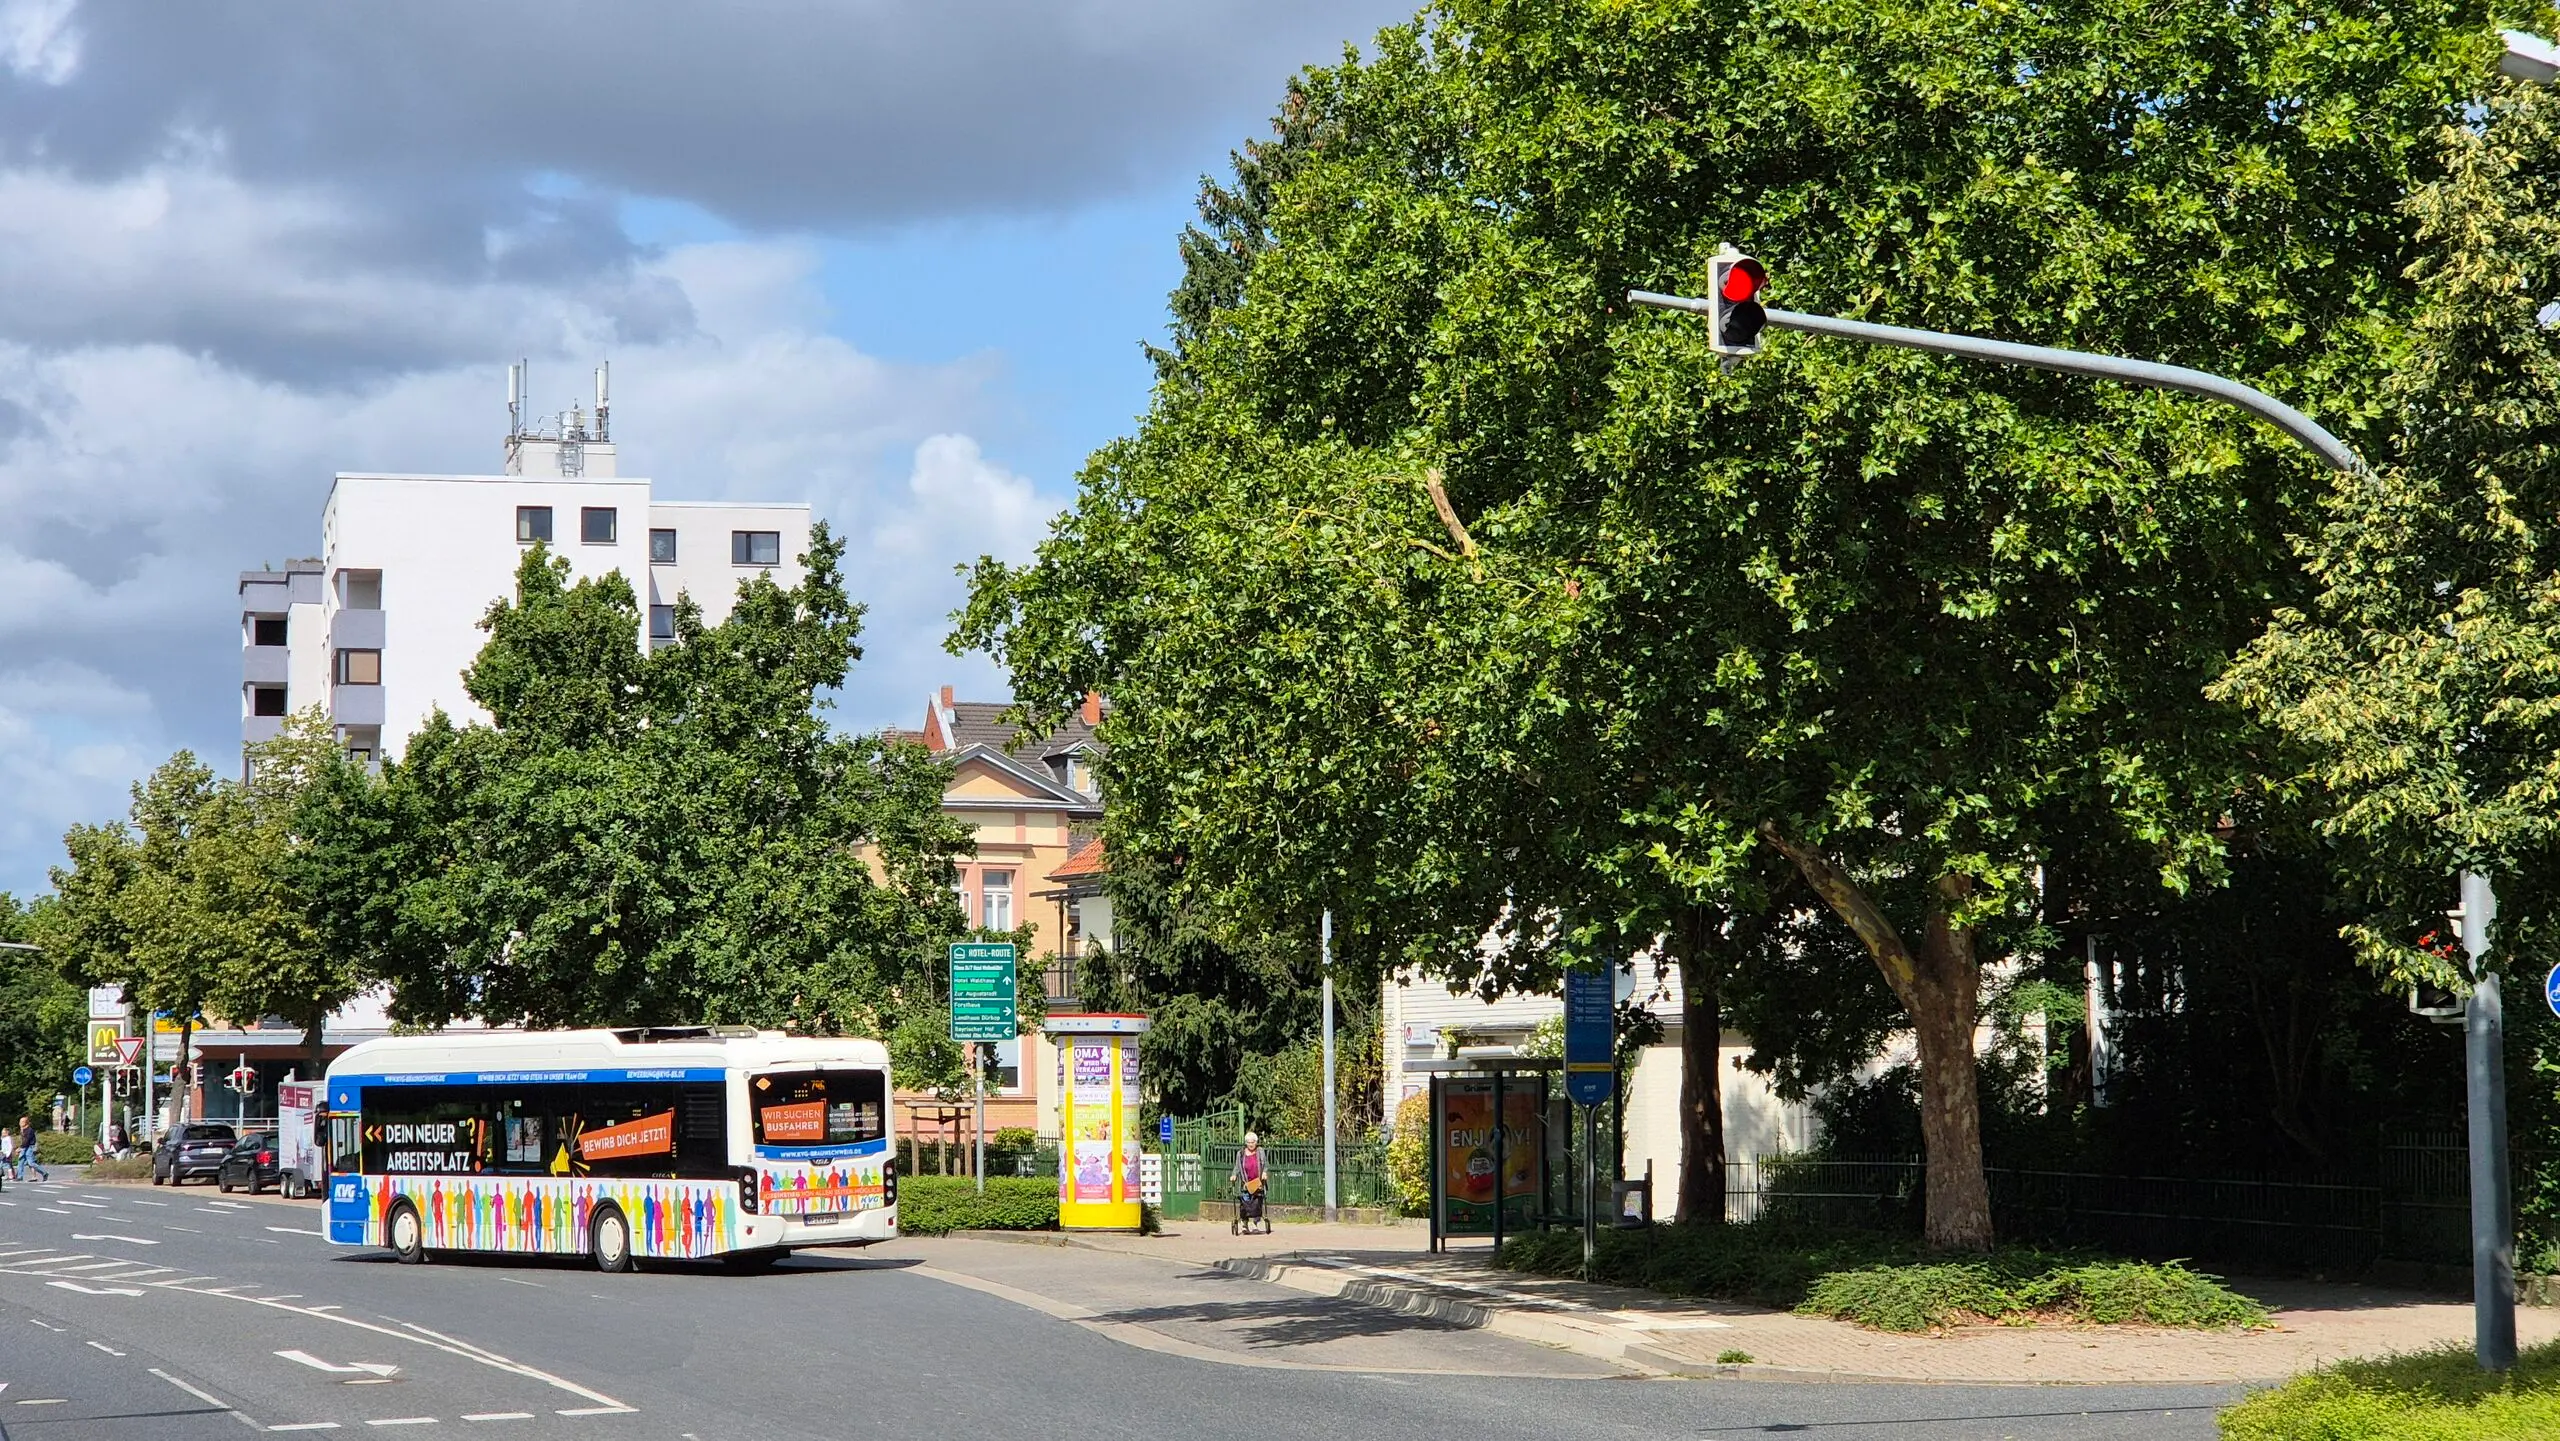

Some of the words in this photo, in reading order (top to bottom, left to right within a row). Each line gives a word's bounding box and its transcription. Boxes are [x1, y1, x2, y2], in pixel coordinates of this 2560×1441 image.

[969, 949, 1011, 957] HOTEL-ROUTE
[1075, 1048, 1099, 1059] OMA
[763, 1111, 781, 1120] WIR
[783, 1109, 821, 1119] SUCHEN
[766, 1121, 820, 1132] BUSFAHRER
[385, 1124, 414, 1143] DEIN
[416, 1124, 456, 1144] NEUER
[584, 1136, 616, 1153] BEWIRB
[616, 1132, 637, 1148] DICH
[639, 1127, 667, 1143] JETZT!
[780, 1148, 863, 1158] WWW.KVG-BRAUNSCHWEIG.DE
[386, 1152, 471, 1172] ARBEITSPLATZ
[334, 1183, 357, 1198] KVG
[861, 1195, 879, 1203] KVG
